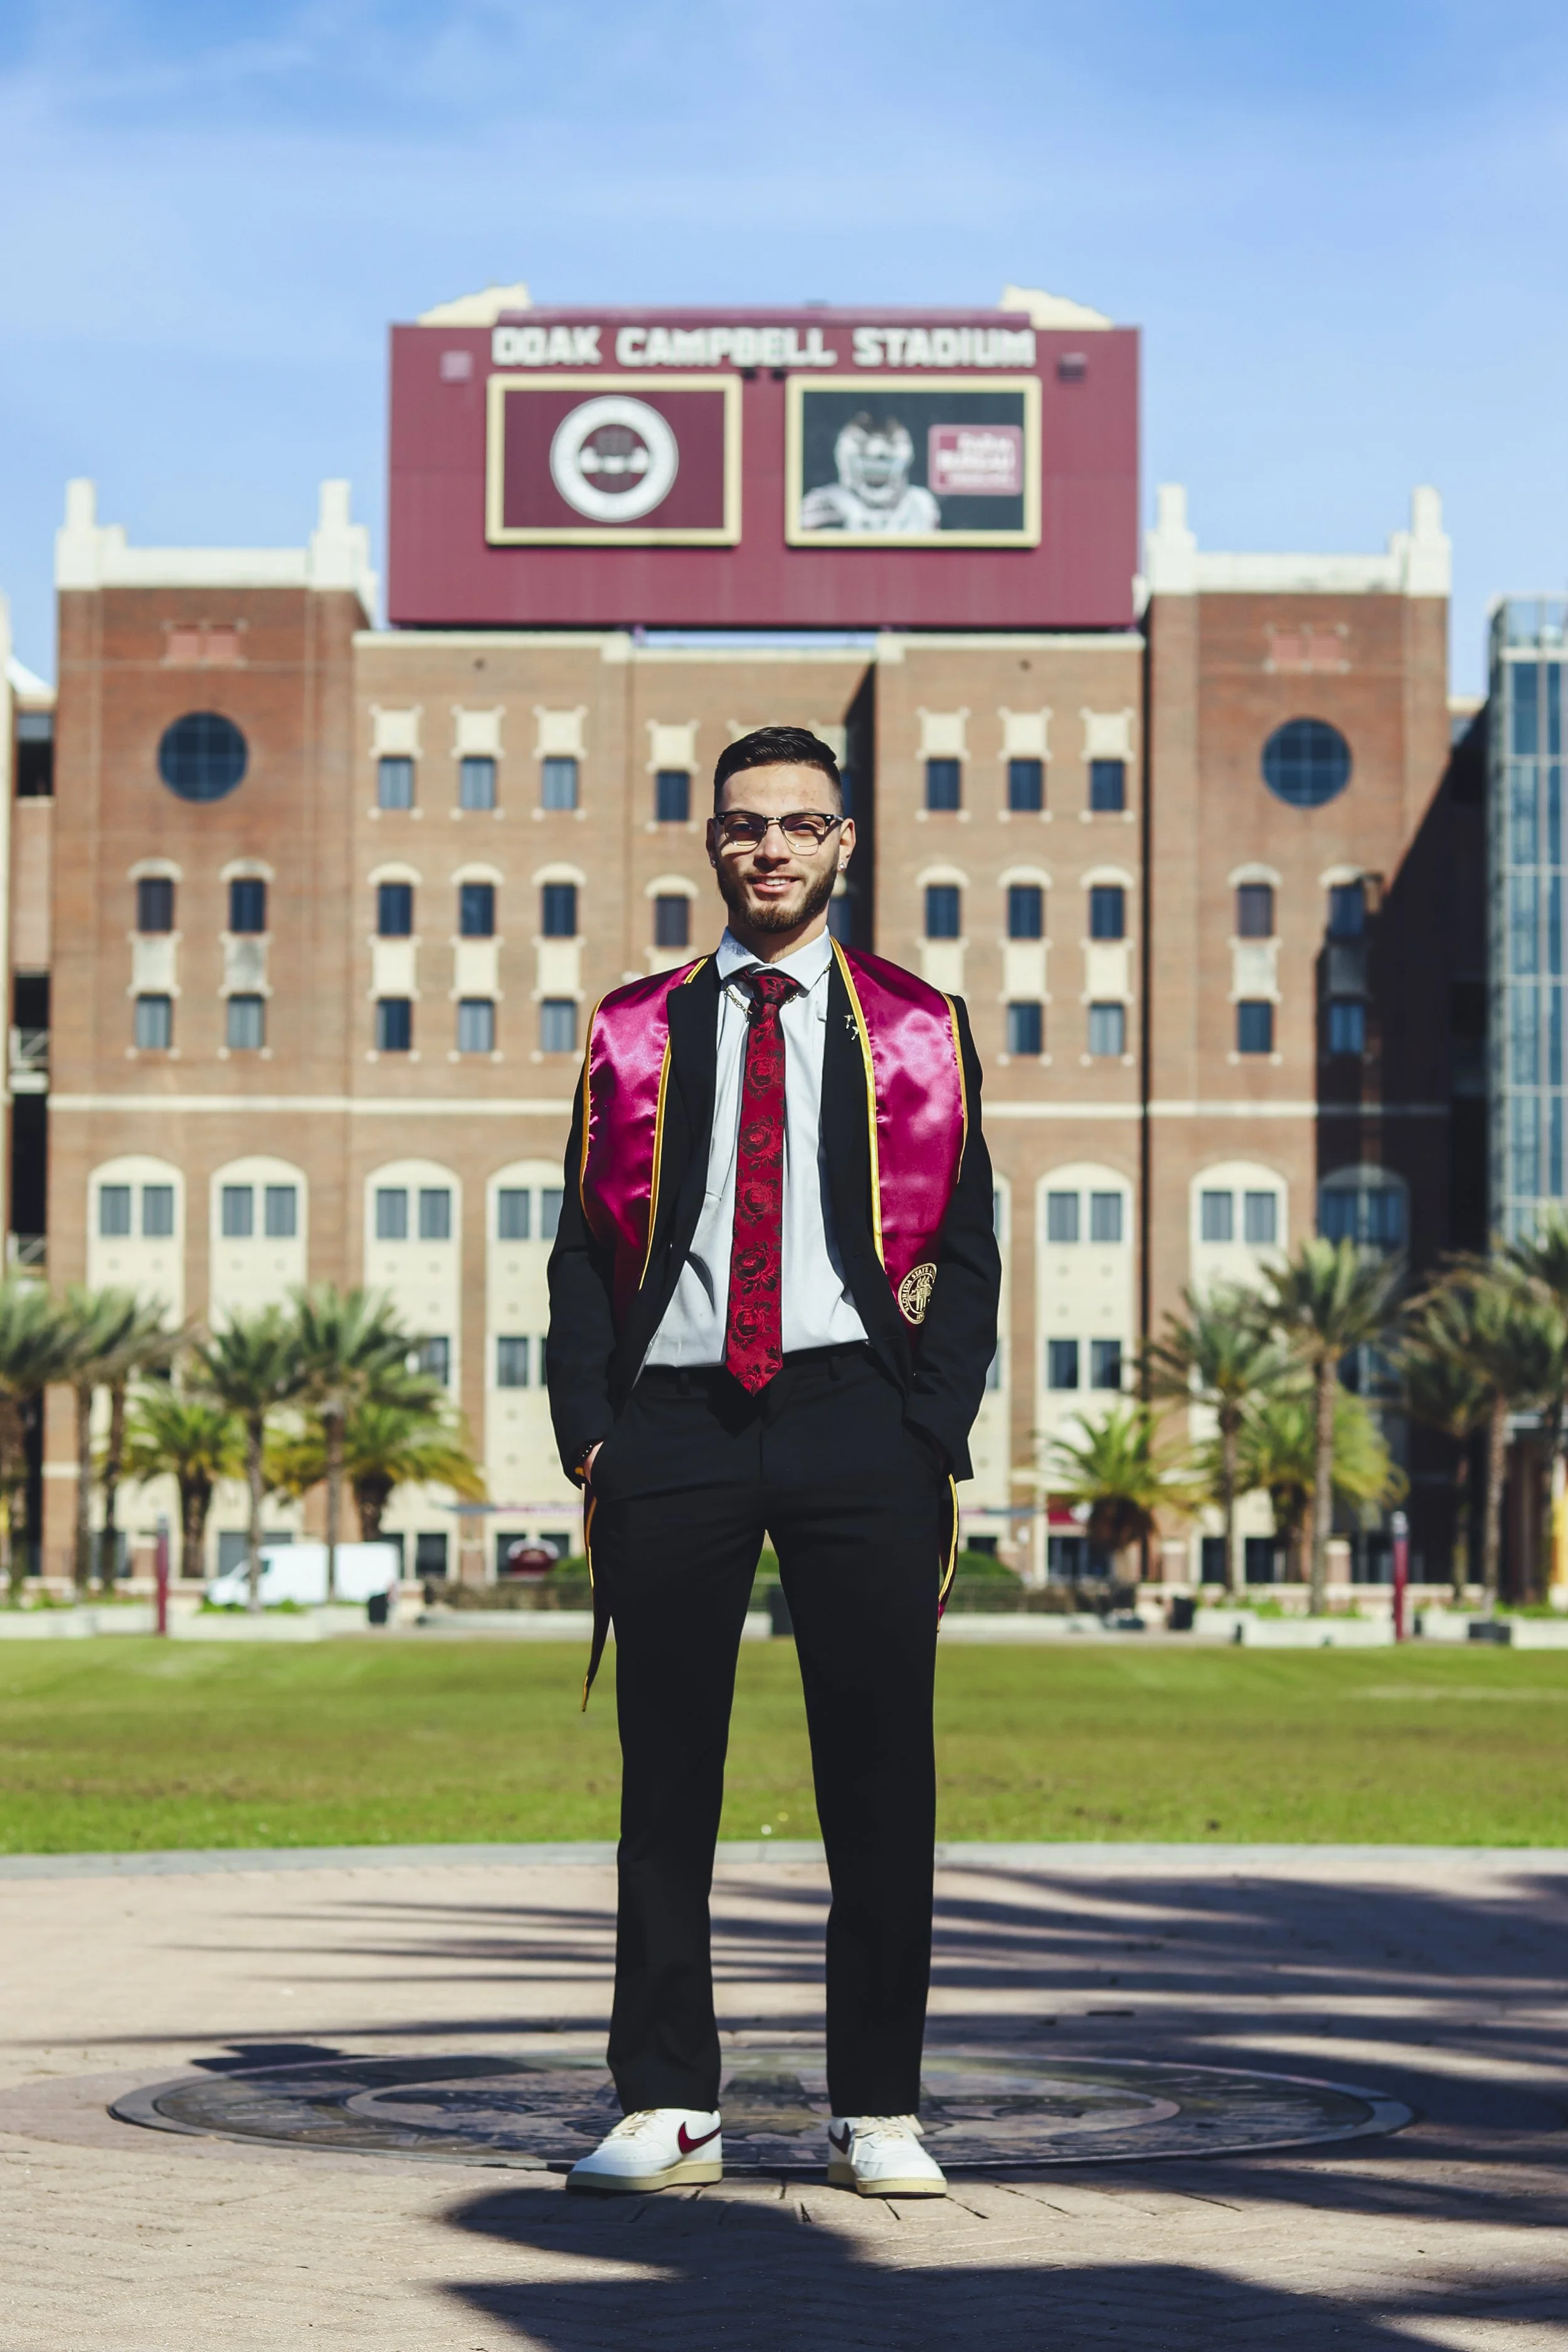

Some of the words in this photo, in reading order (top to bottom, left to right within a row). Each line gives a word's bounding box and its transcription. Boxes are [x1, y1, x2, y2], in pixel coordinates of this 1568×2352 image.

[492, 327, 601, 366] DOAK
[617, 327, 837, 366] CAMPBELL
[853, 327, 1036, 366] STADIUM
[902, 1280, 913, 1313] FLORIDA
[911, 1266, 930, 1279] STATE
